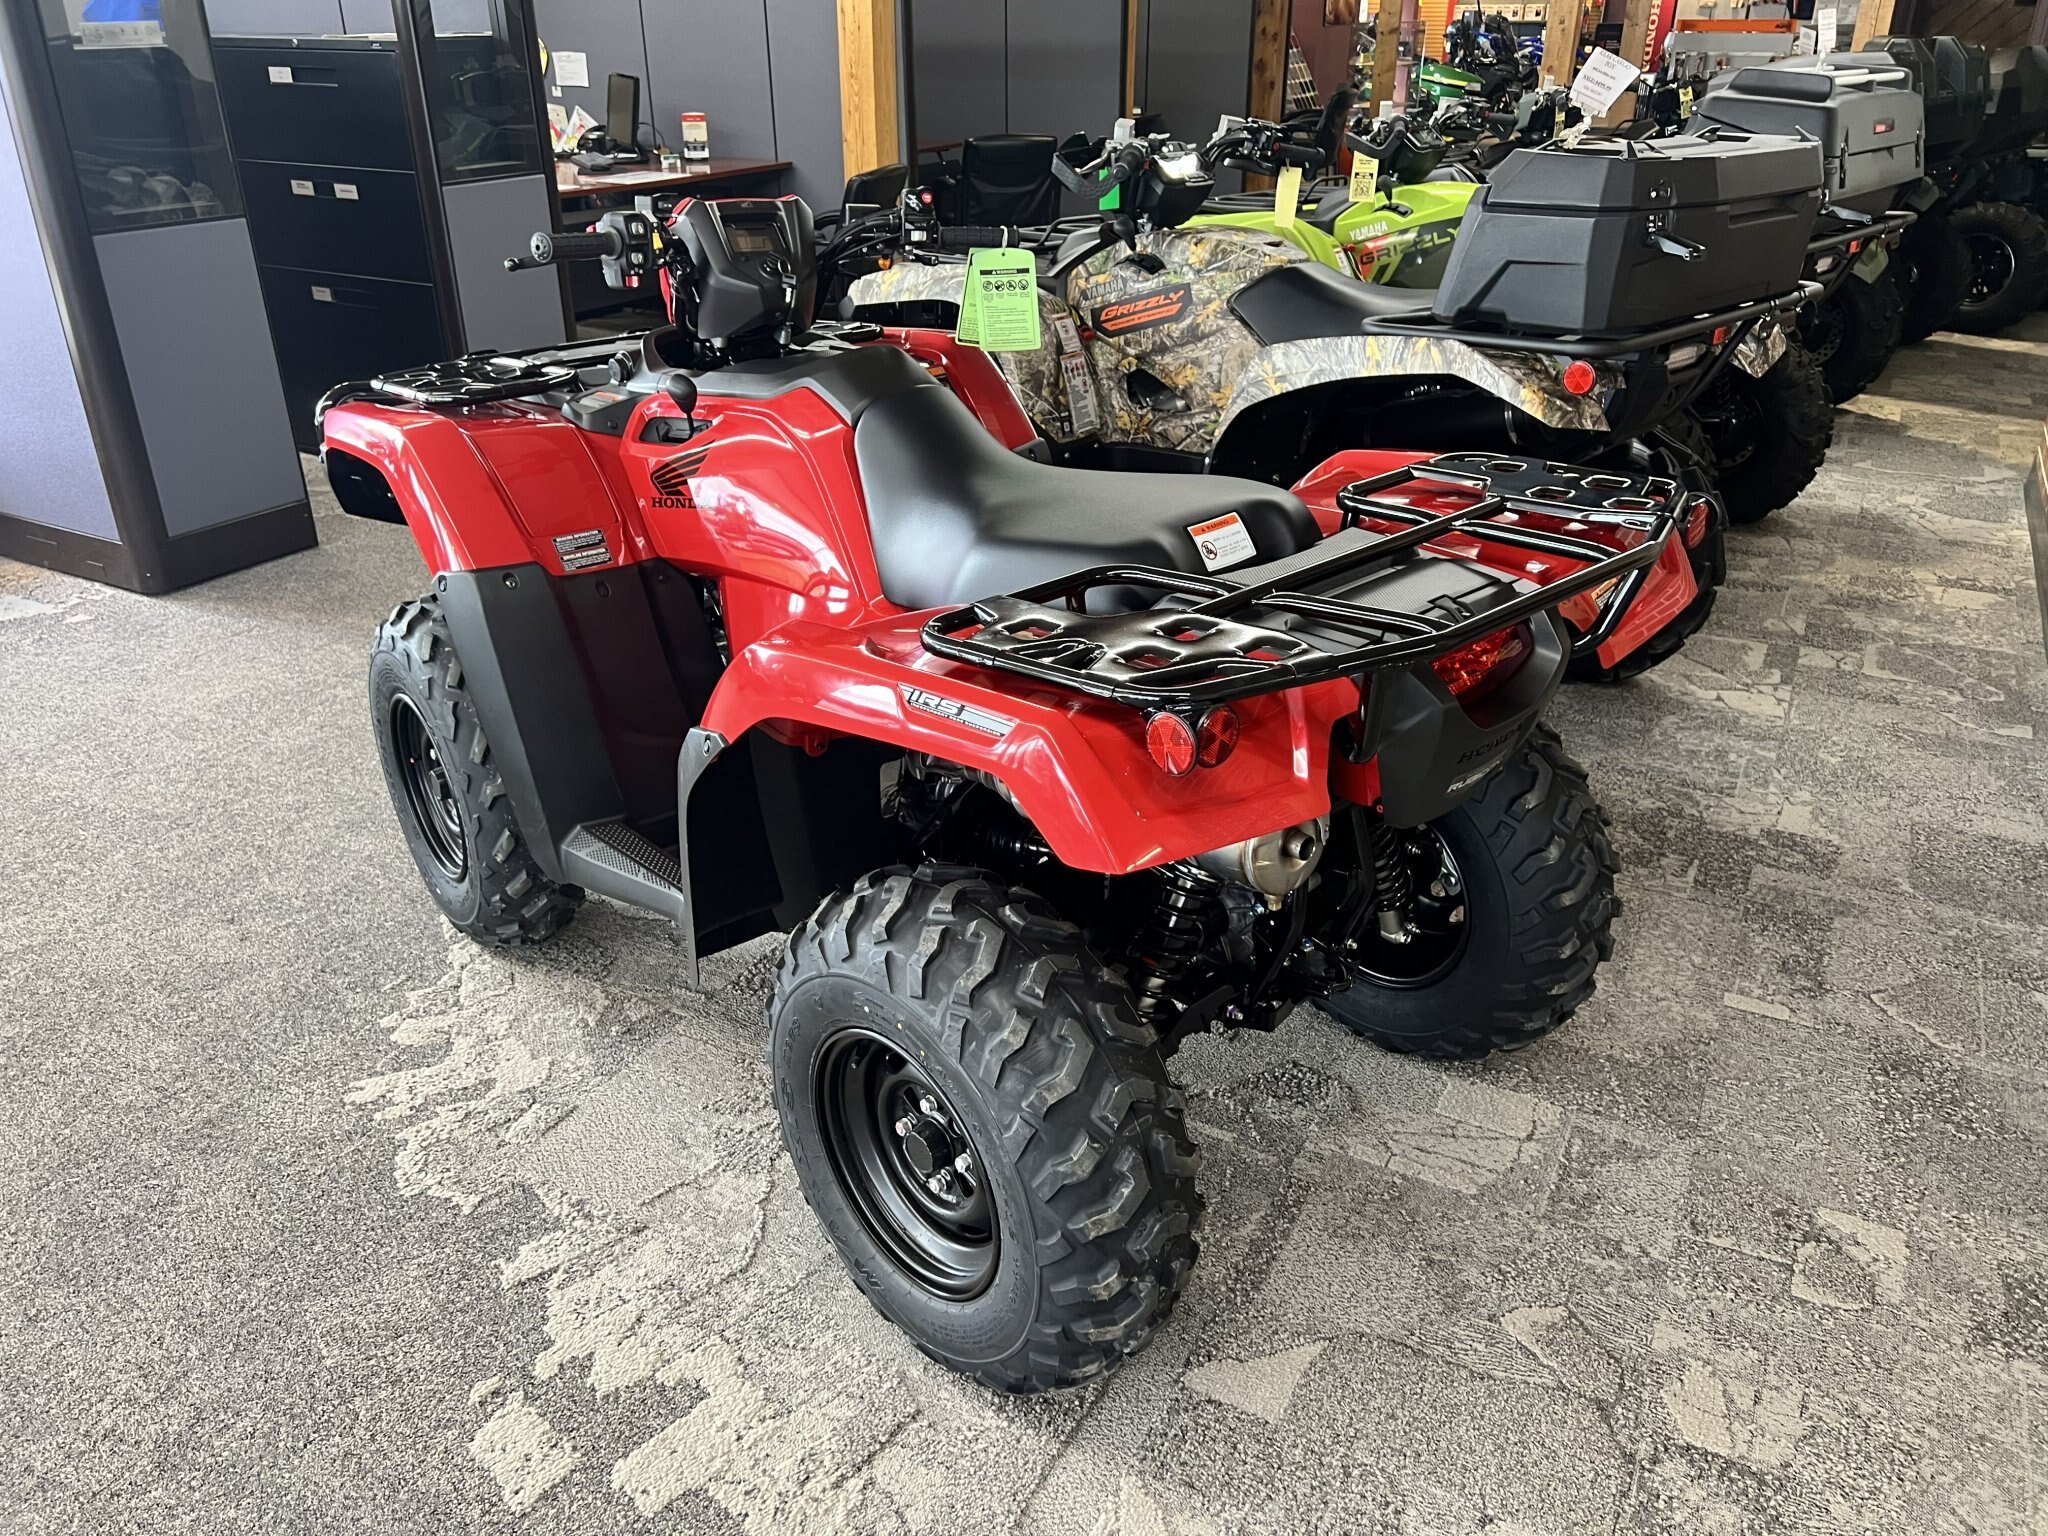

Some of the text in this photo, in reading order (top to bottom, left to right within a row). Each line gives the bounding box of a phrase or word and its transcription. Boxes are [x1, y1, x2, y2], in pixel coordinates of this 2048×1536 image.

[1641, 0, 1662, 72] HONDA
[1349, 221, 1388, 240] YAMAHA
[1360, 226, 1460, 265] GRIZZLY
[1086, 280, 1123, 299] YAMAHA
[1101, 289, 1184, 320] GRIZZLY
[651, 497, 716, 510] HOND
[1206, 518, 1229, 531] WARNING
[910, 688, 962, 716] IRS
